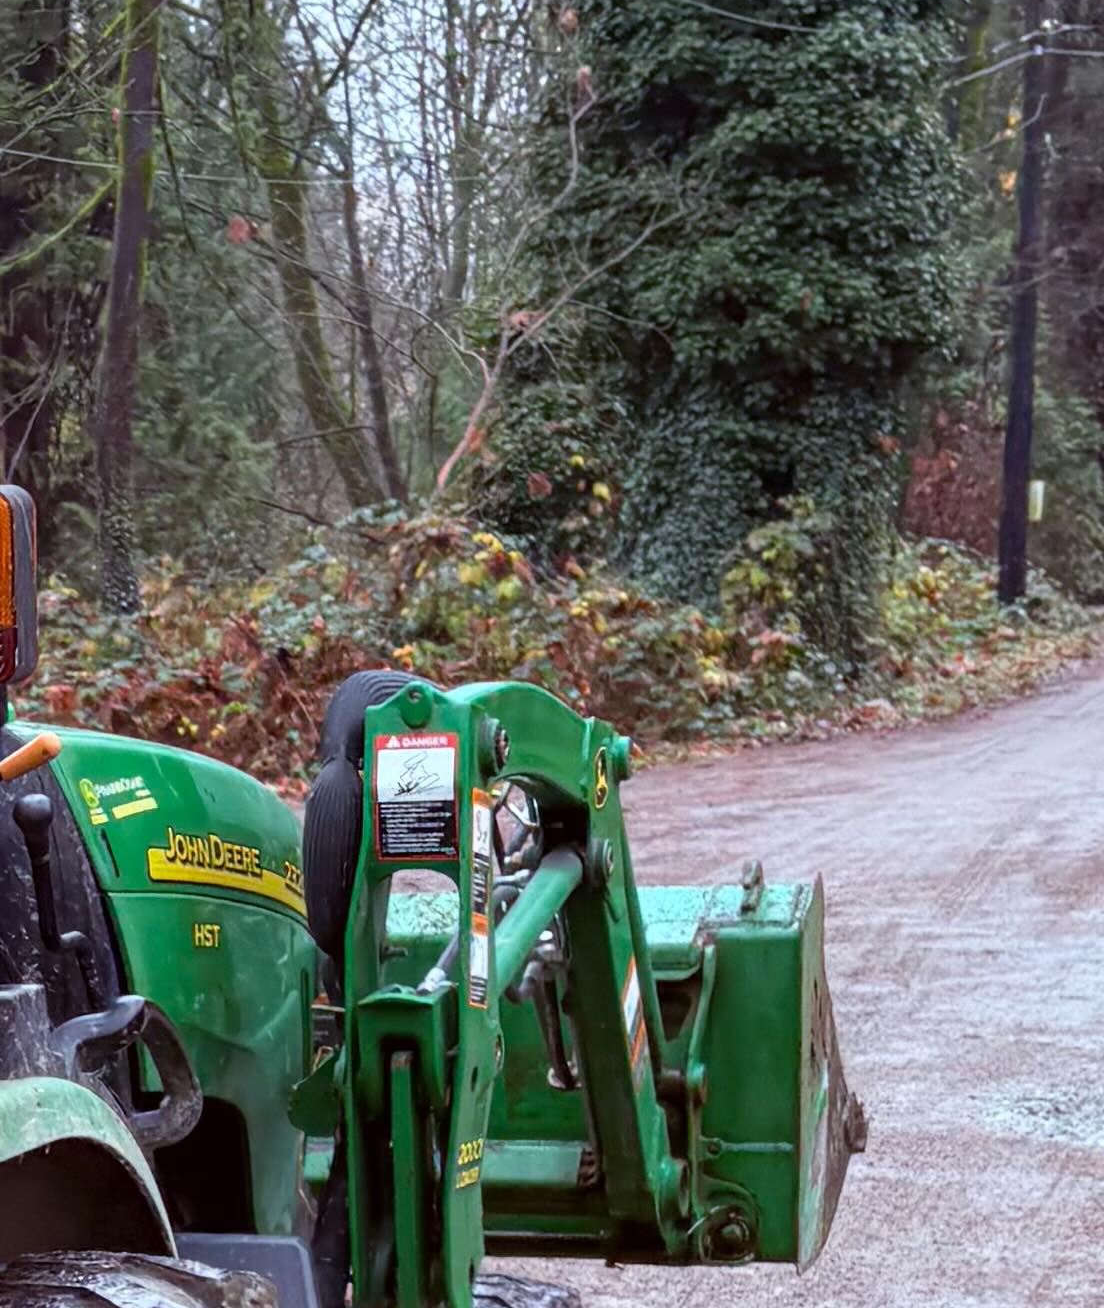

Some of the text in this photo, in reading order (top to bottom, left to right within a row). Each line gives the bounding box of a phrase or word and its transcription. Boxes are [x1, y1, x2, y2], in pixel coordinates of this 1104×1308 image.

[166, 826, 262, 875] JOHN DEERE
[194, 923, 221, 948] HST
